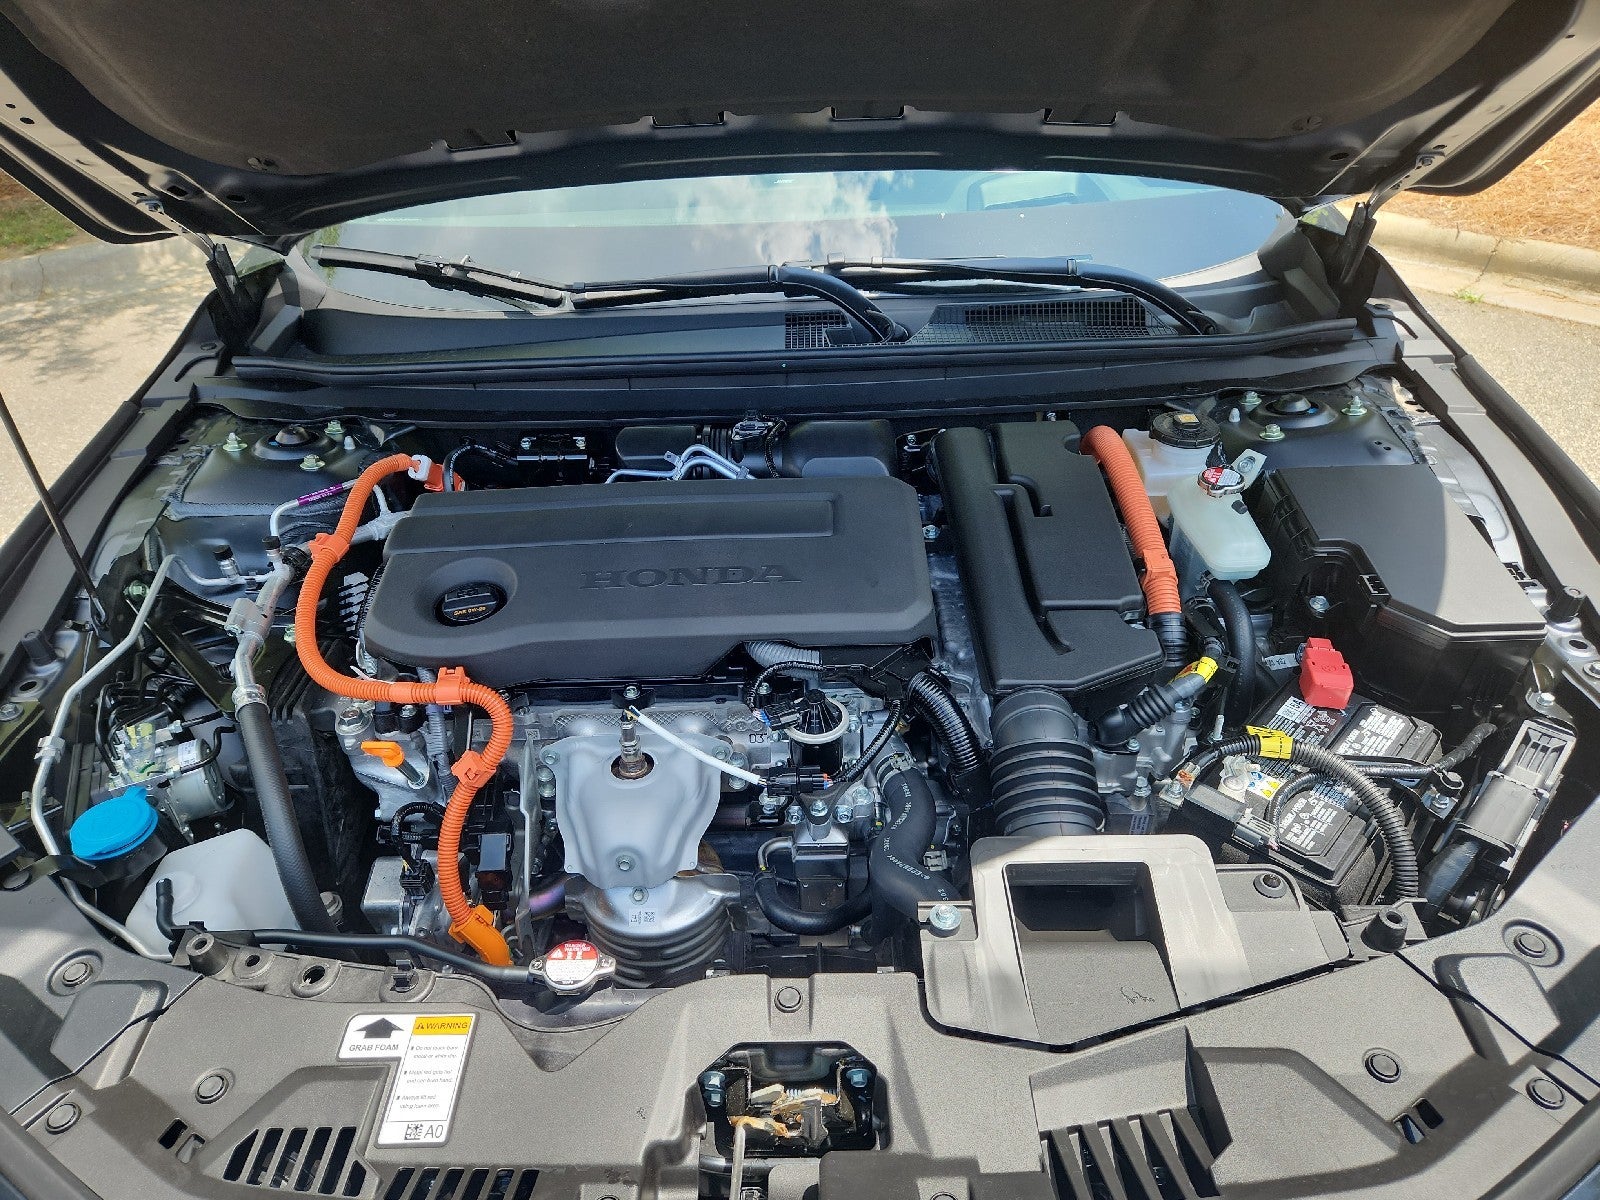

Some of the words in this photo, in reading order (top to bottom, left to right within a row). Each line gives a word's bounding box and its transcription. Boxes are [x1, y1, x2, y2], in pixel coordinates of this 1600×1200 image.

[580, 565, 802, 590] HONDA
[426, 1022, 468, 1030] WARNING
[349, 1044, 373, 1052] GRAB
[424, 1125, 444, 1139] A0
